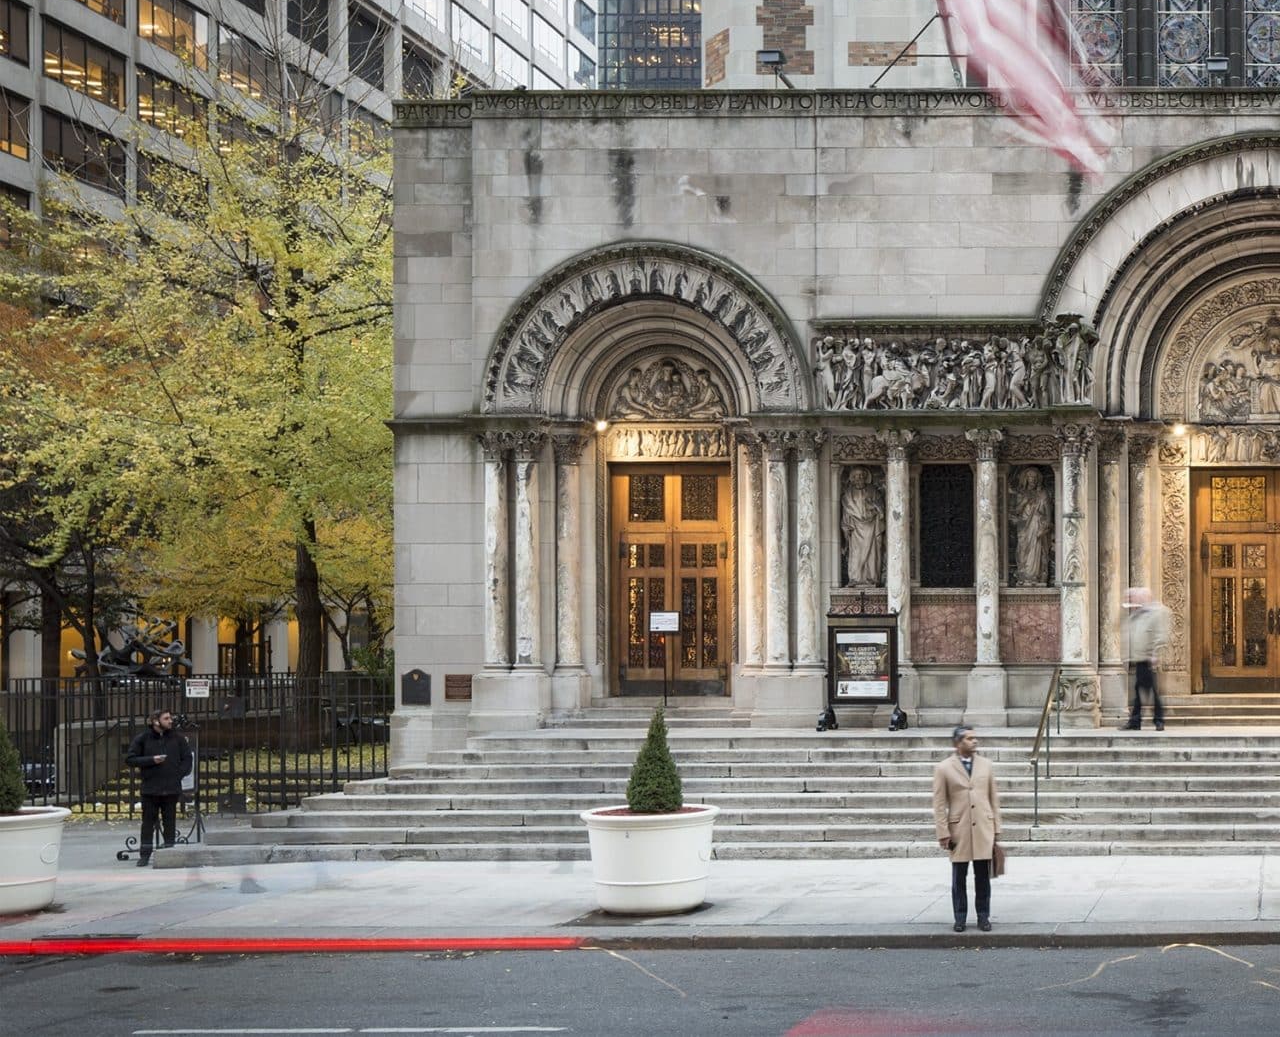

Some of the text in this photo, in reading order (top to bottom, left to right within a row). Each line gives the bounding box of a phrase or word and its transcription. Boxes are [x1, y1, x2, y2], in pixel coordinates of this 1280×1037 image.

[504, 95, 562, 110] GRACE
[631, 95, 656, 110] TO
[660, 95, 740, 110] BELIEVE
[741, 95, 783, 110] AND
[788, 95, 813, 110] TO
[819, 93, 899, 109] PREACH
[903, 93, 944, 109] THY
[1086, 92, 1115, 108] WE
[1119, 92, 1204, 108] BESEECH
[1210, 92, 1261, 108] THEE
[395, 105, 472, 120] BARTHO
